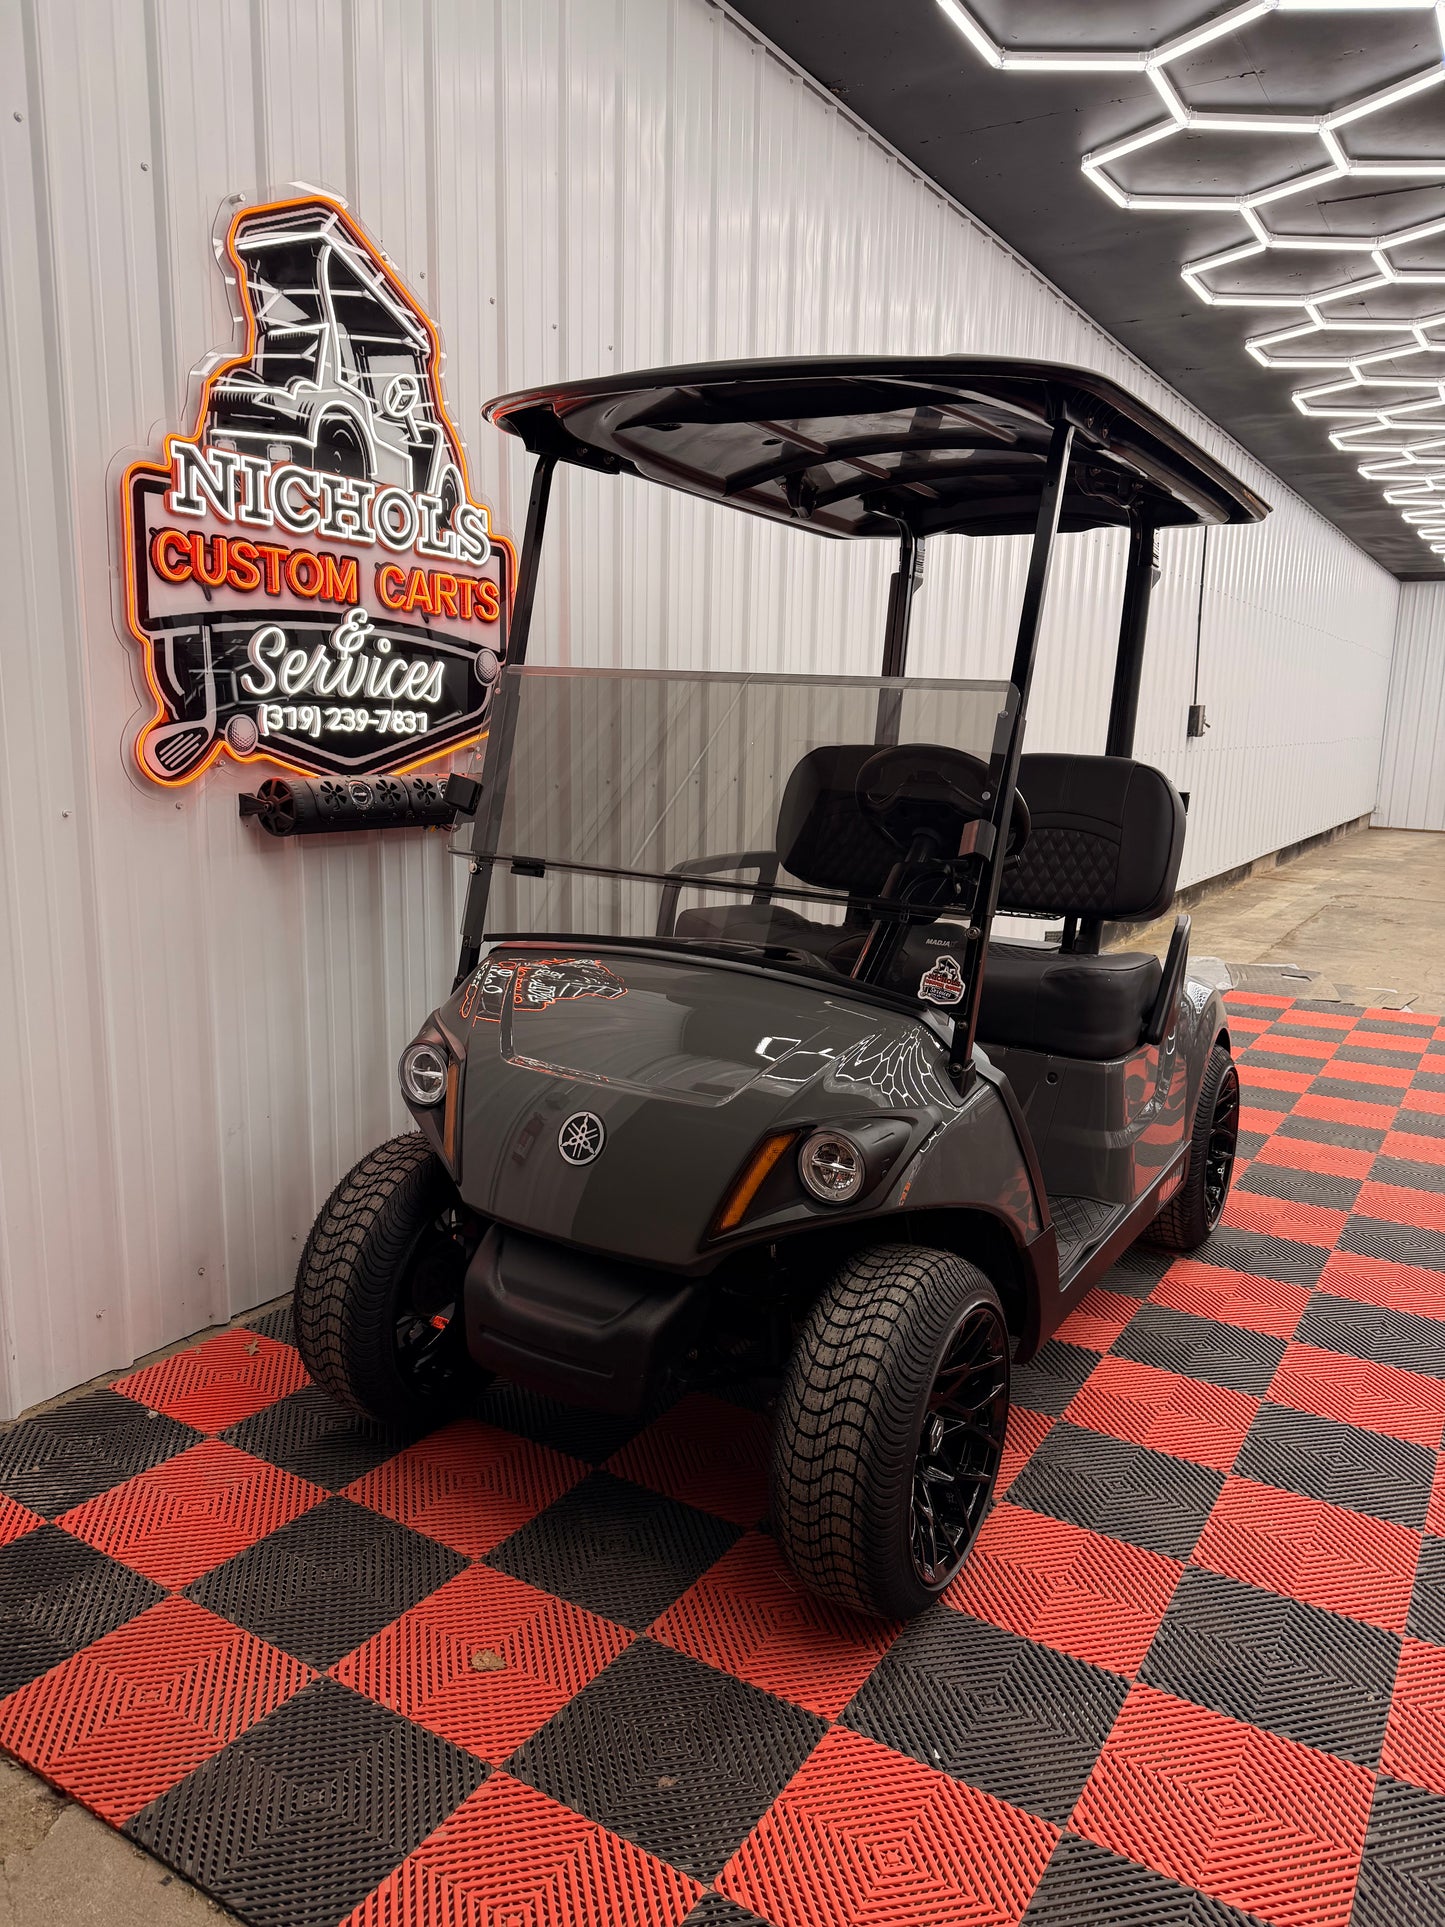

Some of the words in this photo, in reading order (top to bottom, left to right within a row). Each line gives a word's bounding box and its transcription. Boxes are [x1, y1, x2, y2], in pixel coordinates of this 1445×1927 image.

[169, 440, 491, 566] NICHOLS
[151, 528, 358, 604] CUSTOM
[376, 563, 500, 622] CARTS
[241, 625, 445, 703] Services
[331, 607, 374, 661] &
[322, 707, 428, 734] 239-7831
